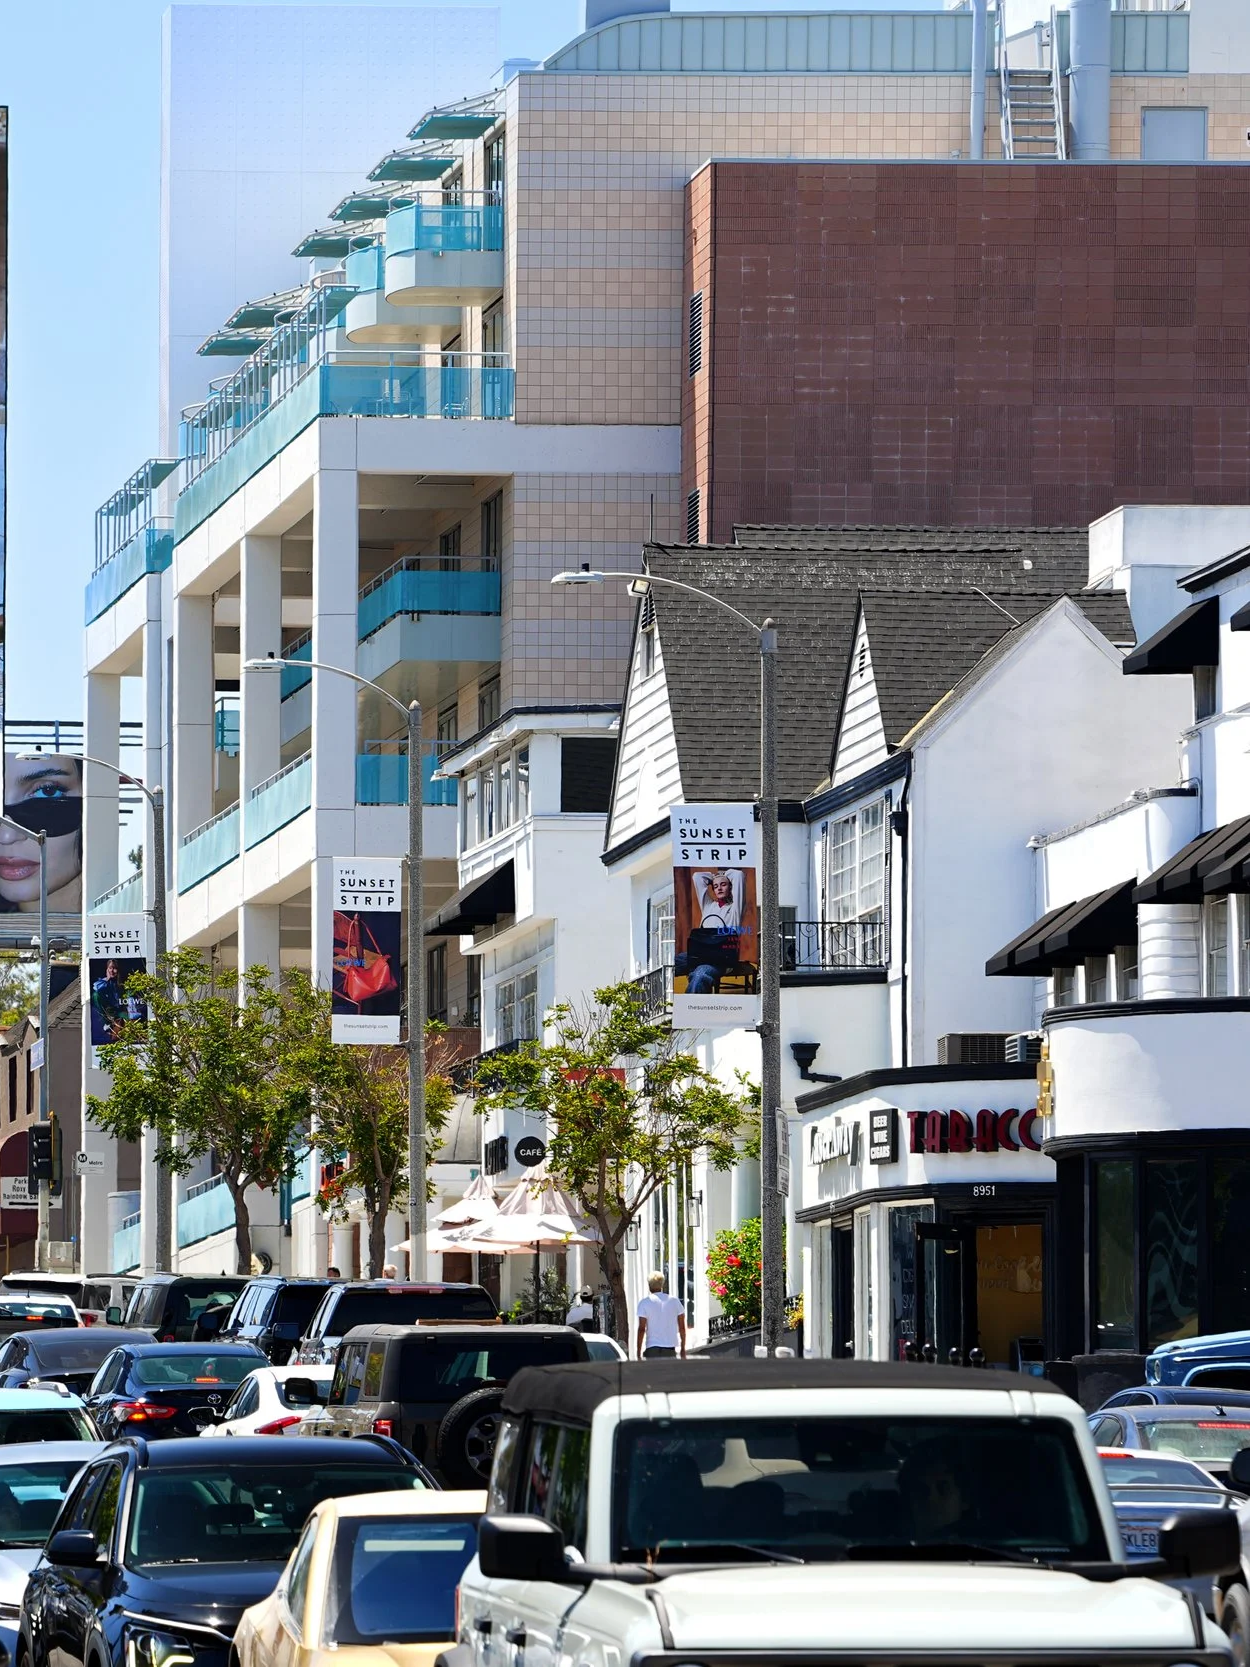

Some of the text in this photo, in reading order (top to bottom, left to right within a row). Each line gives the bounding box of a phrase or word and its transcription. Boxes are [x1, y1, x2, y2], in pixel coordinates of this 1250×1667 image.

[679, 828, 747, 839] SUNSET
[681, 849, 748, 861] STRIP
[340, 878, 395, 888] SUNSET
[340, 895, 395, 906] STRIP
[94, 930, 140, 939] SUNSET
[94, 945, 140, 954] STRIP
[519, 1147, 542, 1157] CAFÉ
[12, 1185, 27, 1193] Roxy
[973, 1185, 996, 1197] 8951
